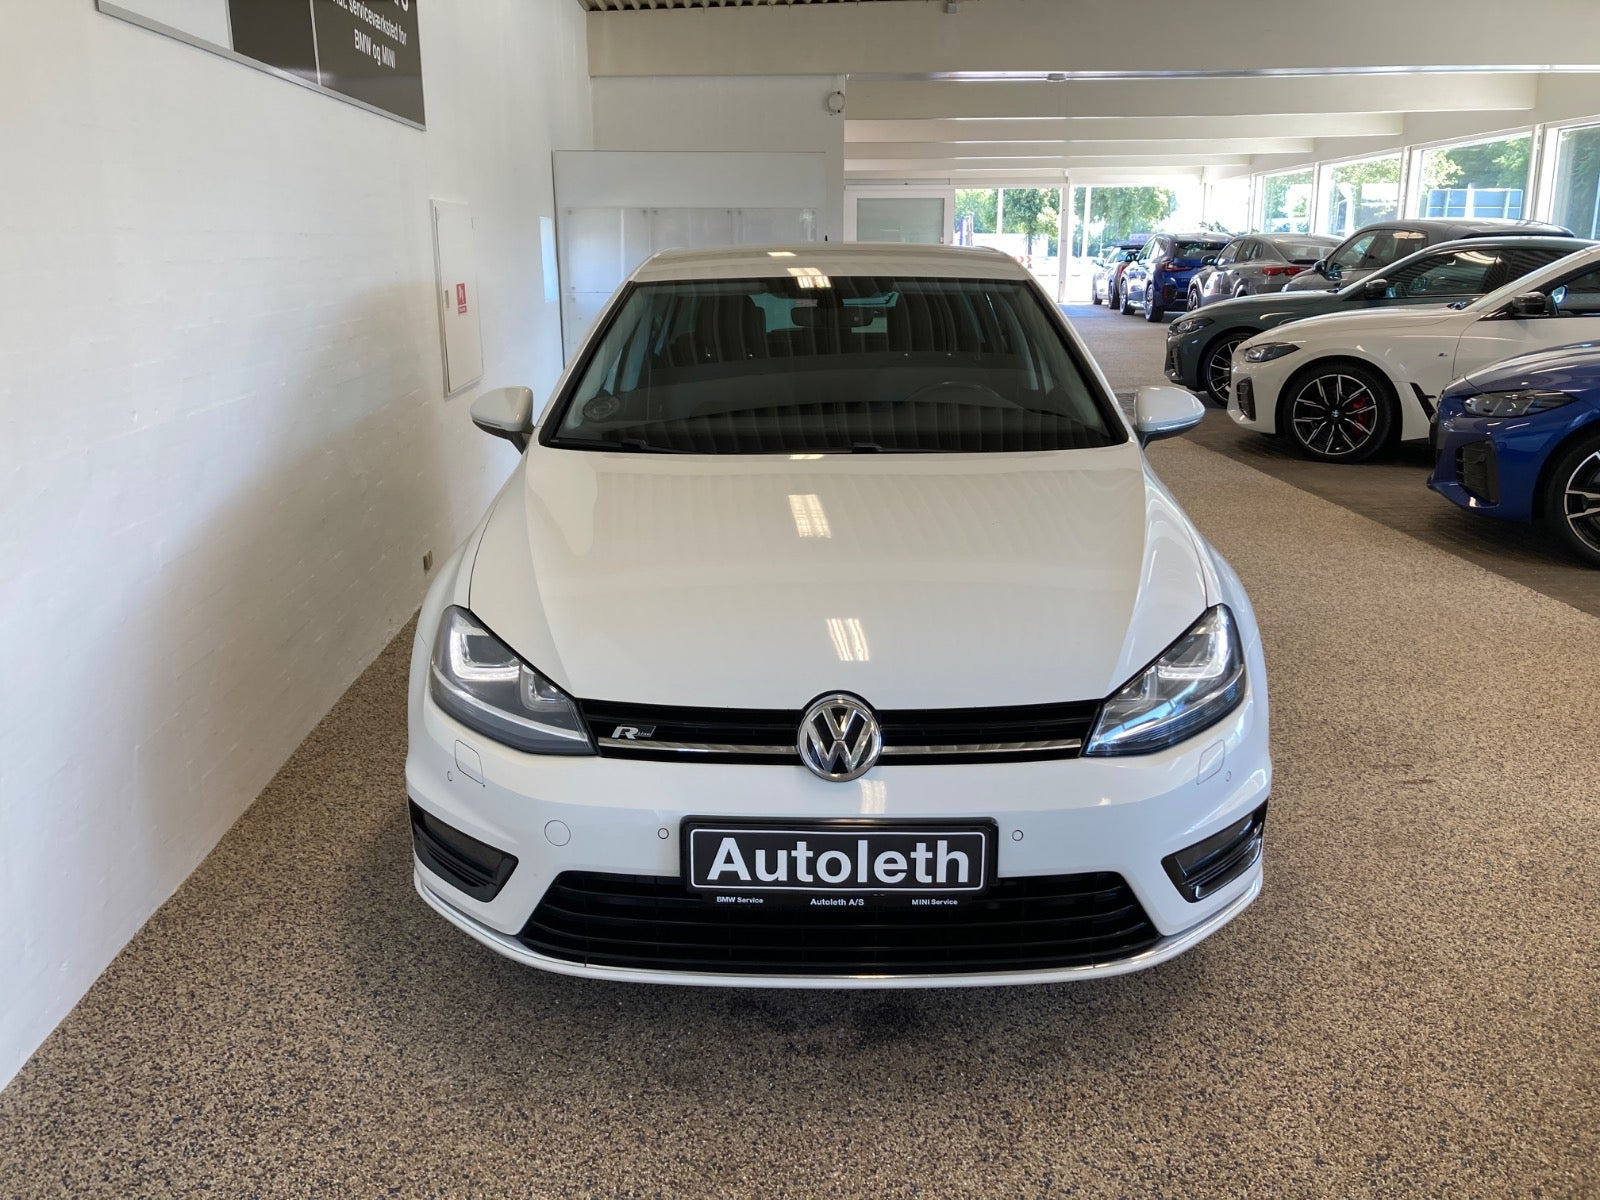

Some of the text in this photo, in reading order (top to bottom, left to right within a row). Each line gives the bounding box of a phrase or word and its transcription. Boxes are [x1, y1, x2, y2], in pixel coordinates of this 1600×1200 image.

[399, 25, 407, 46] for
[354, 29, 396, 68] BMW og MINI
[706, 837, 969, 883] Autoleth
[737, 896, 764, 904] Service
[810, 898, 864, 906] Autoleth A/S
